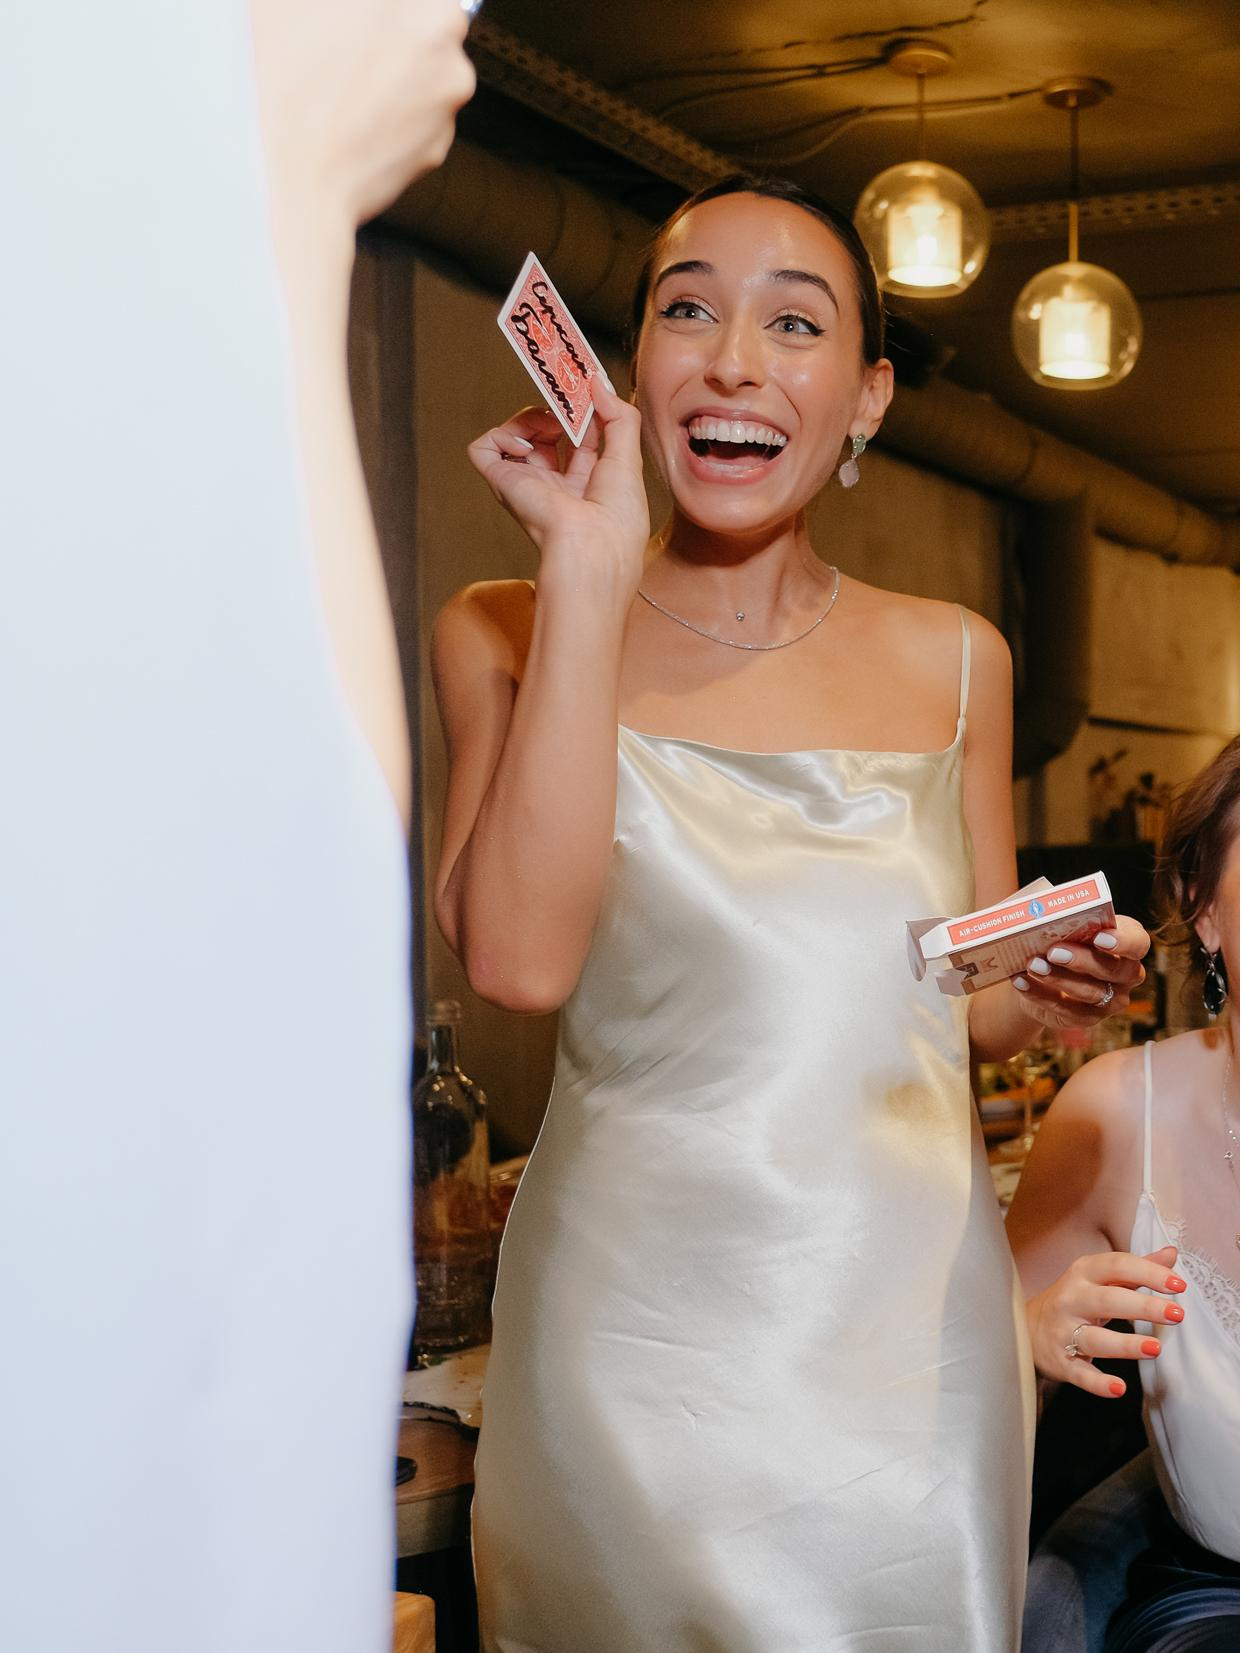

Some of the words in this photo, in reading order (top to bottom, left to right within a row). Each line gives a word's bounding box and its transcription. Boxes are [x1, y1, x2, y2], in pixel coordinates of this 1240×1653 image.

[1047, 898, 1066, 908] MADE
[1066, 893, 1075, 902] IN
[1076, 889, 1090, 899] USA
[959, 918, 1002, 937] AIR-CUSHION
[1002, 910, 1025, 922] FINISH
